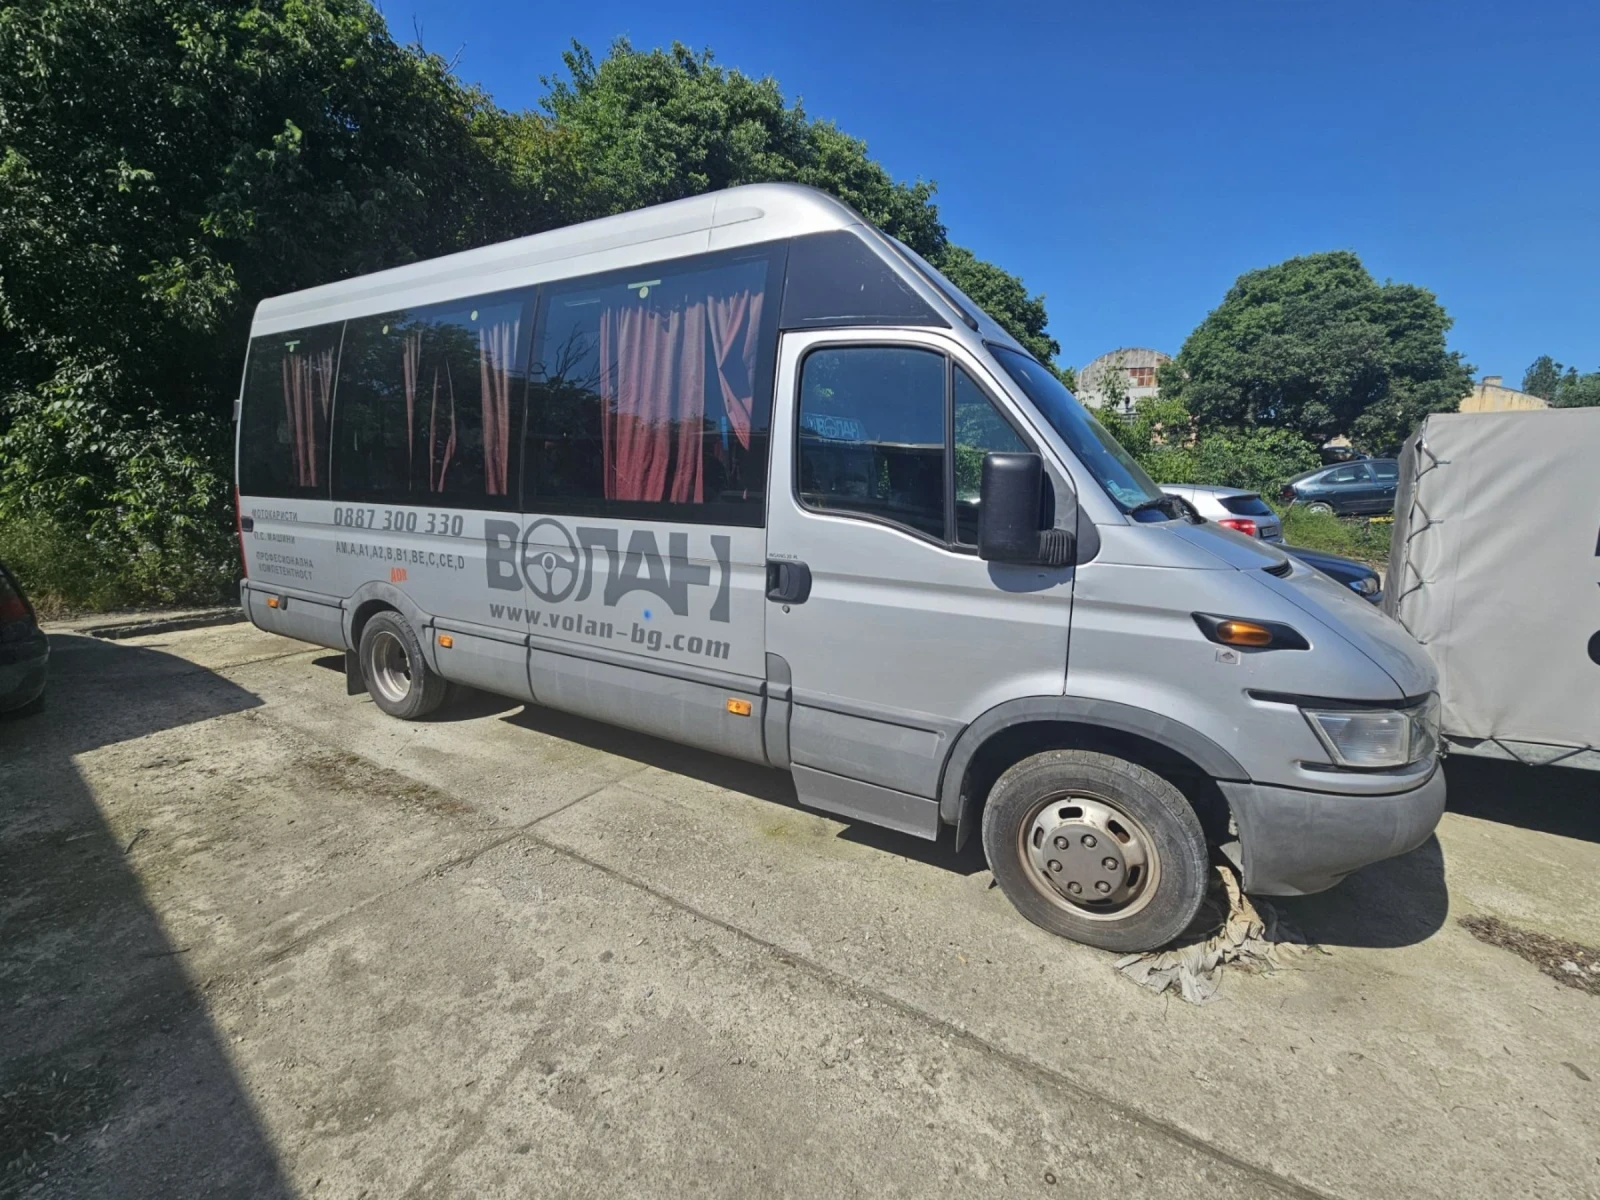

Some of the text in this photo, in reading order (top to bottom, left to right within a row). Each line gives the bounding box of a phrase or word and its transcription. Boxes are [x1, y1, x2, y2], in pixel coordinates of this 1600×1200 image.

[252, 508, 298, 522] МОТОКАРИСТИ
[333, 507, 464, 537] 0887 300 330
[267, 532, 296, 545] МАШИНИ
[256, 551, 314, 568] ПРОФЕСИОНАЛНА
[258, 563, 313, 580] КОМПЕТЕНТНОСТ
[390, 567, 407, 583] ADR
[484, 518, 731, 623] ВОЛАН
[489, 603, 731, 660] www.volan-bg.com
